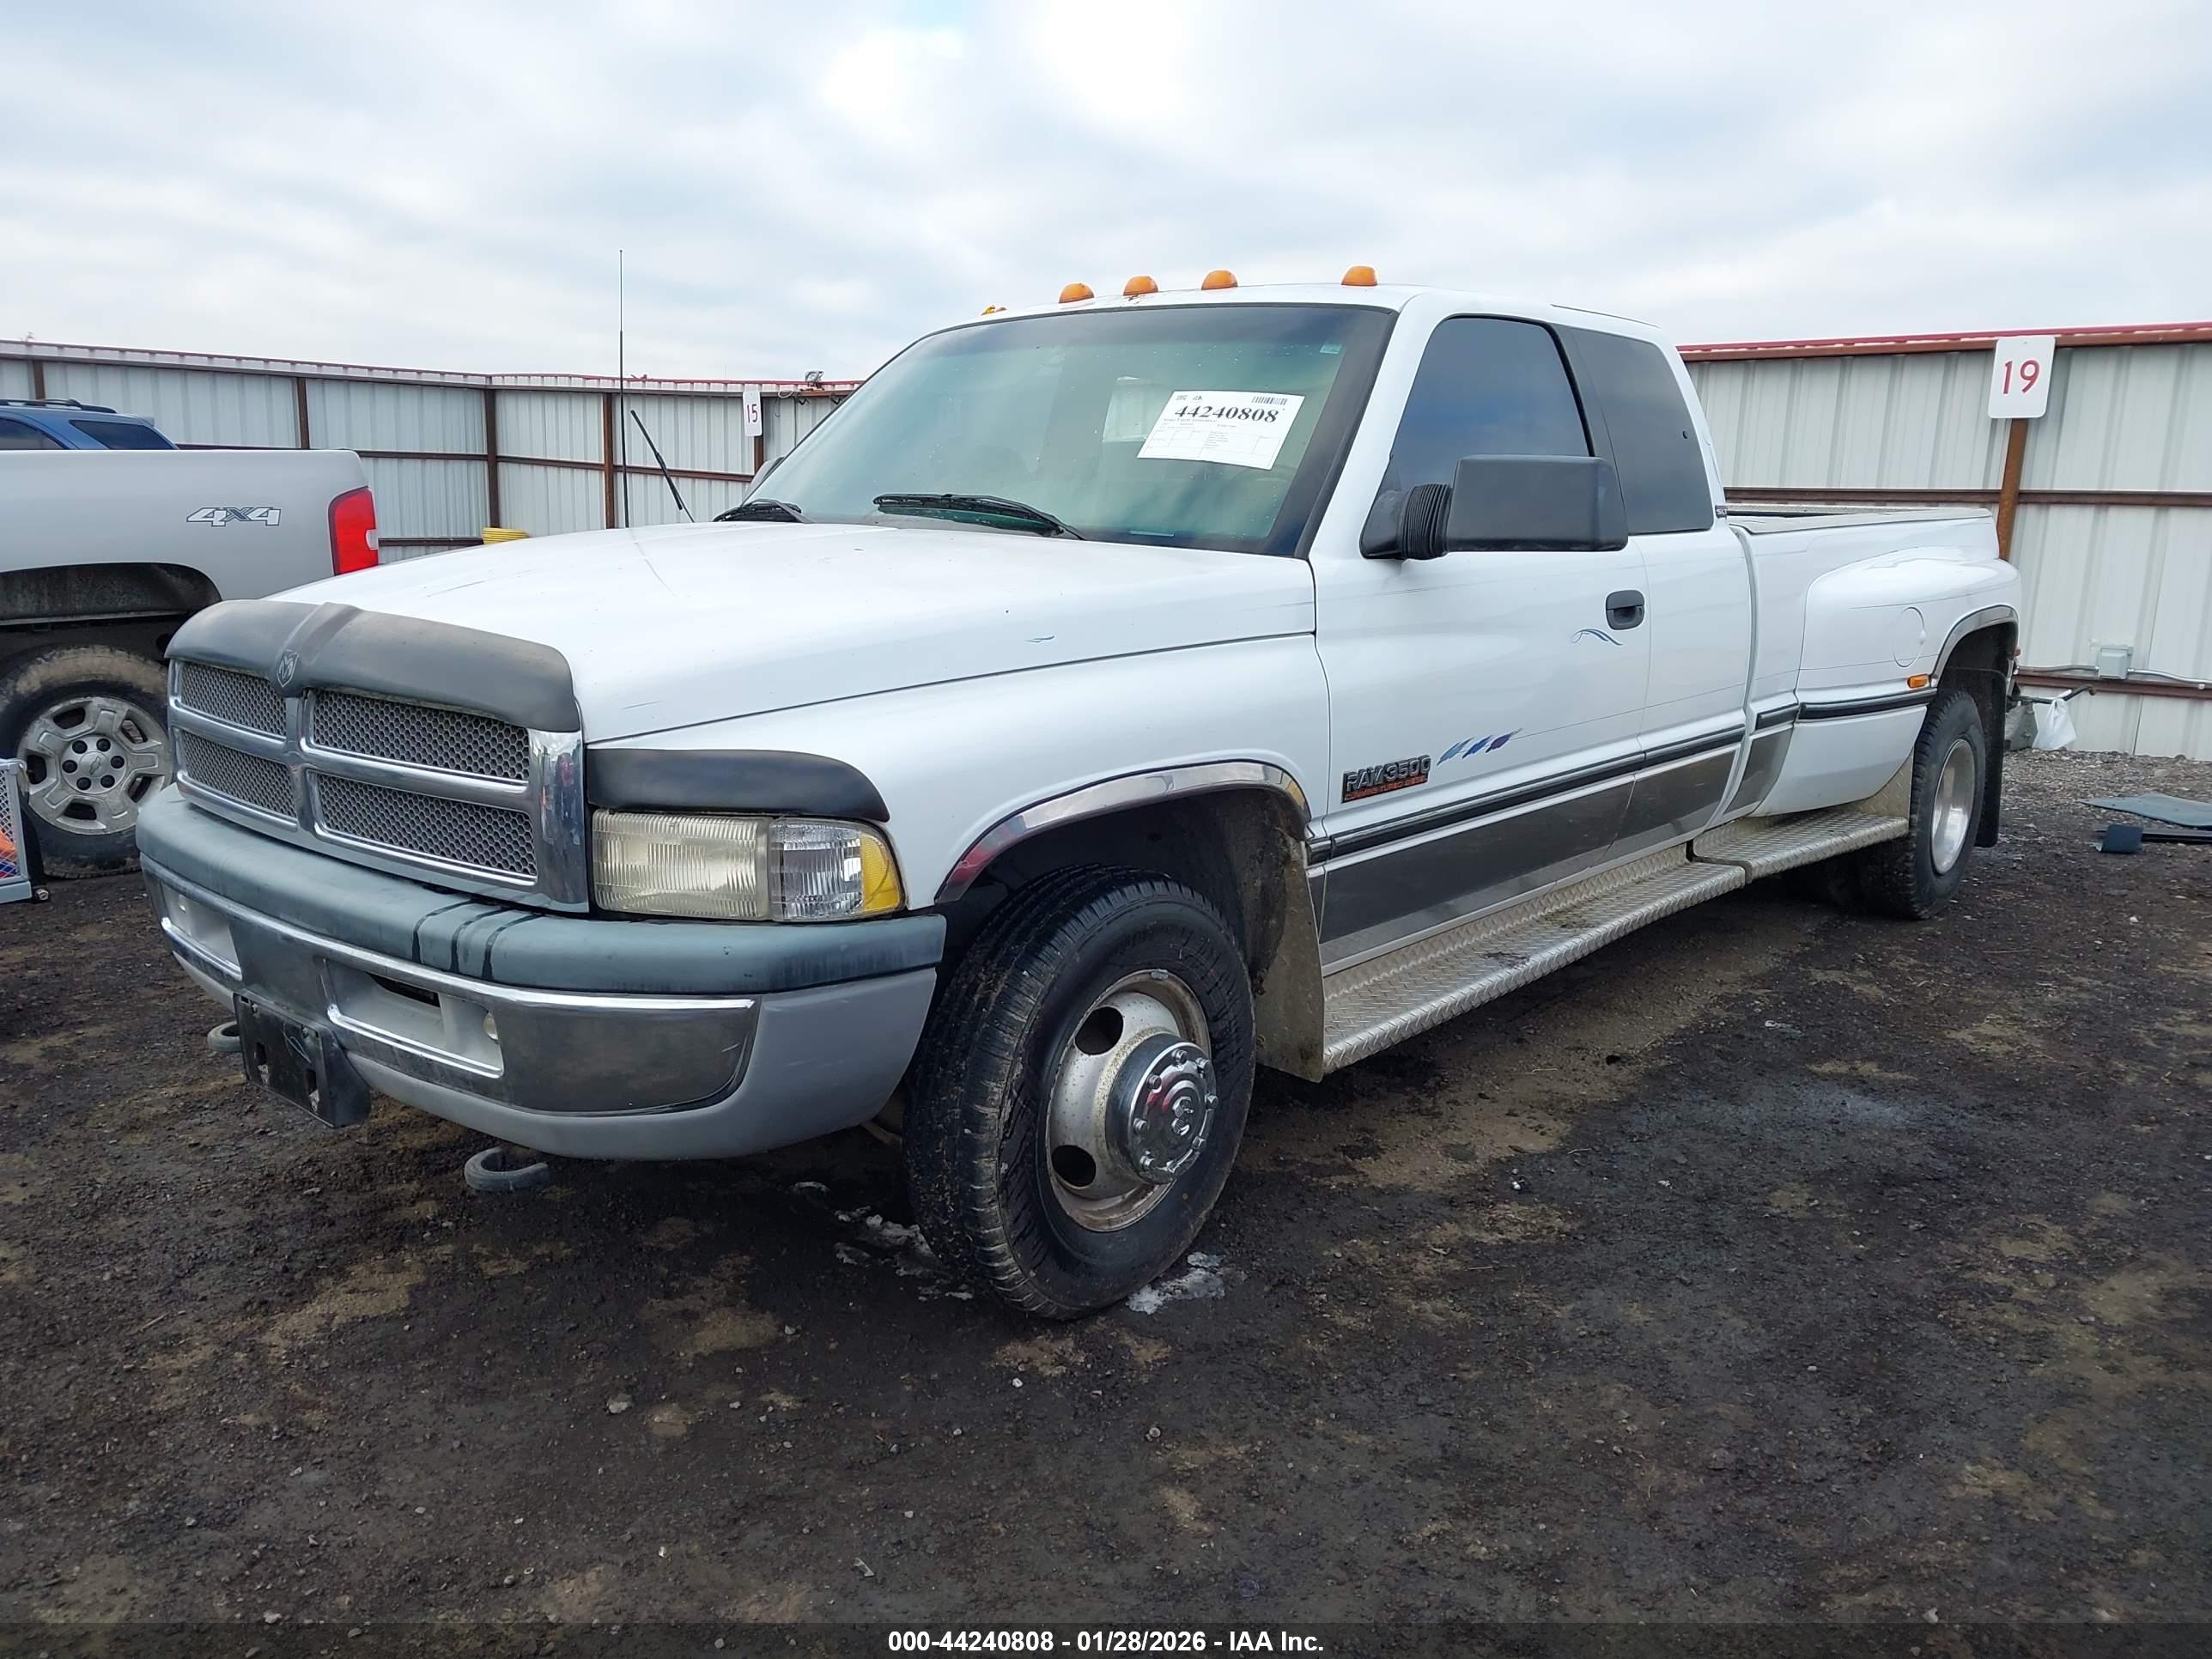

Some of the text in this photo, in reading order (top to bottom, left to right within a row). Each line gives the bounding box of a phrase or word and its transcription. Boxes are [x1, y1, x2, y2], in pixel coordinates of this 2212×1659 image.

[2002, 359, 2040, 395] 19
[746, 404, 759, 423] 15
[1174, 405, 1279, 423] 44240808
